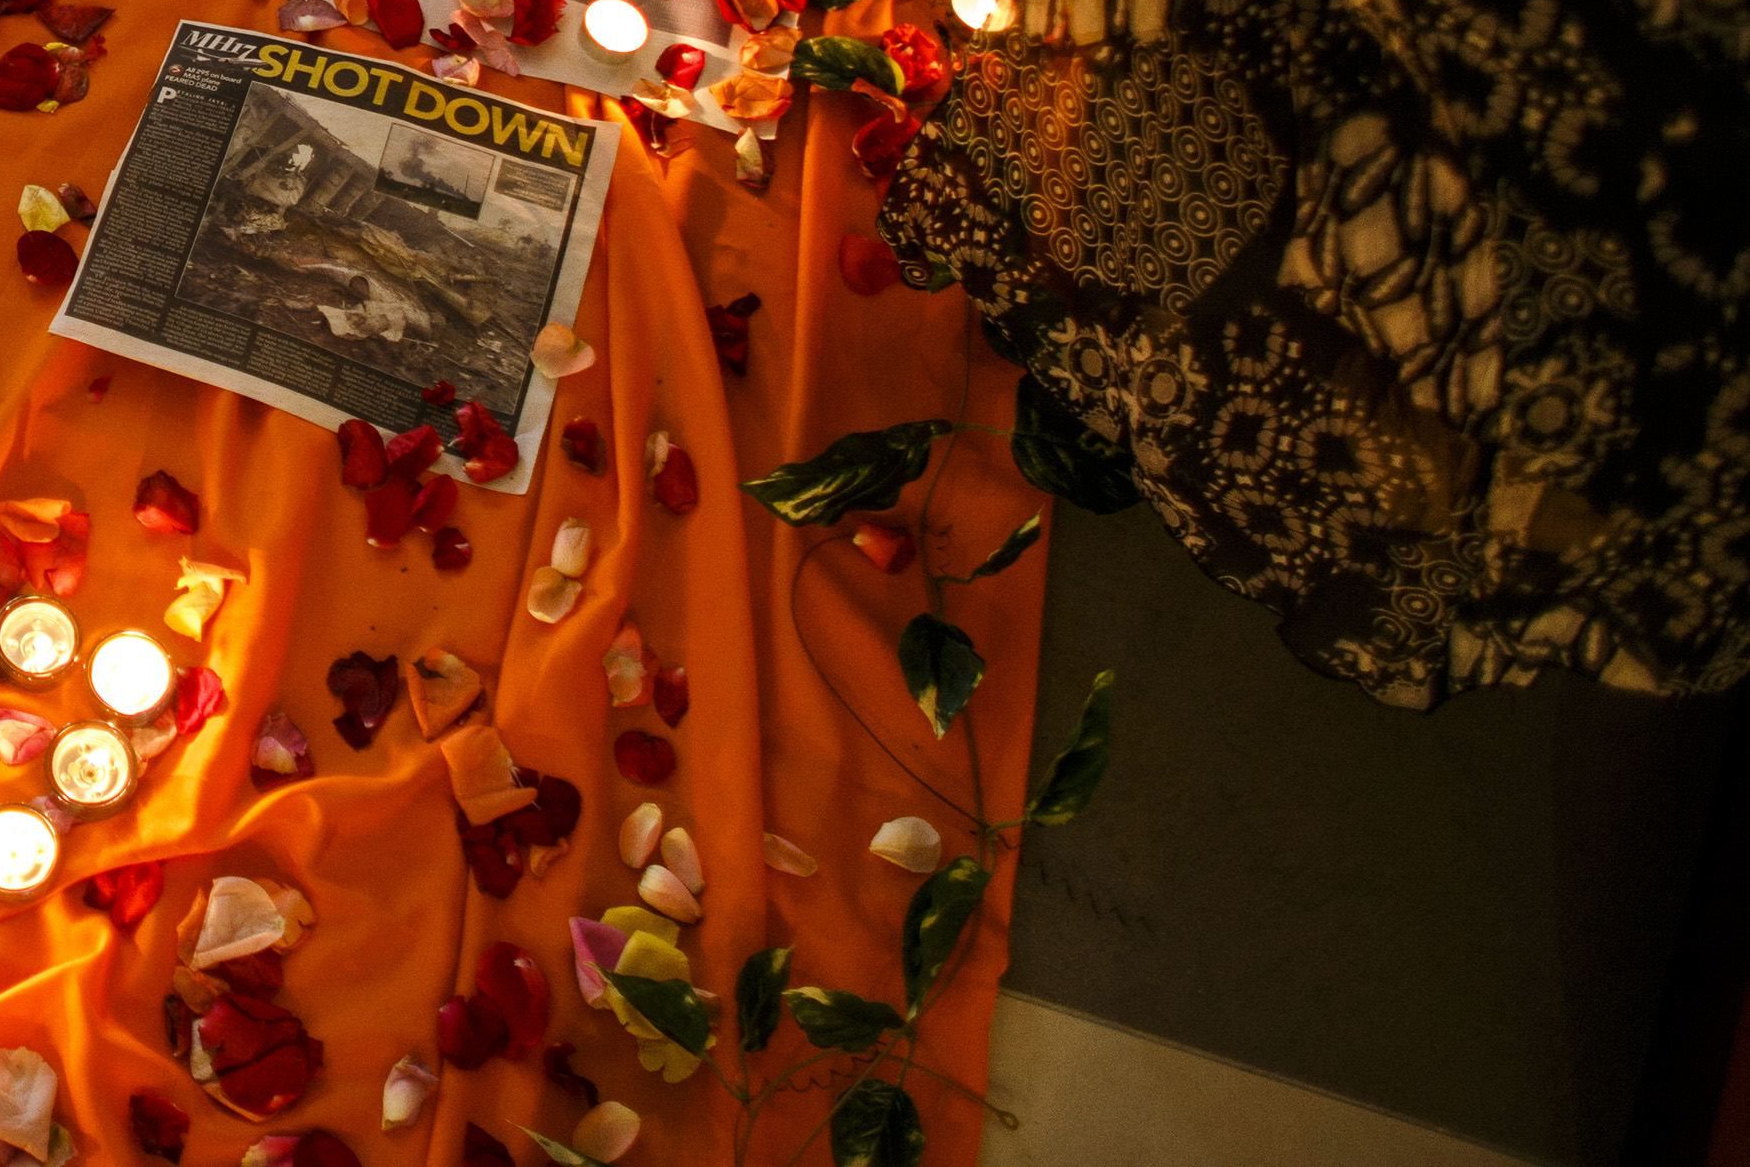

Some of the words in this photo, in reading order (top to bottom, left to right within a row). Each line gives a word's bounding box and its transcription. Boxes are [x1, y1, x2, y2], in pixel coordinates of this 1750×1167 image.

[165, 74, 195, 86] FEARED
[195, 82, 218, 91] DEAD
[183, 72, 201, 81] MAS
[220, 74, 242, 84] board
[180, 30, 257, 60] MH17
[251, 44, 403, 107] SHOT
[403, 81, 589, 167] DOWN
